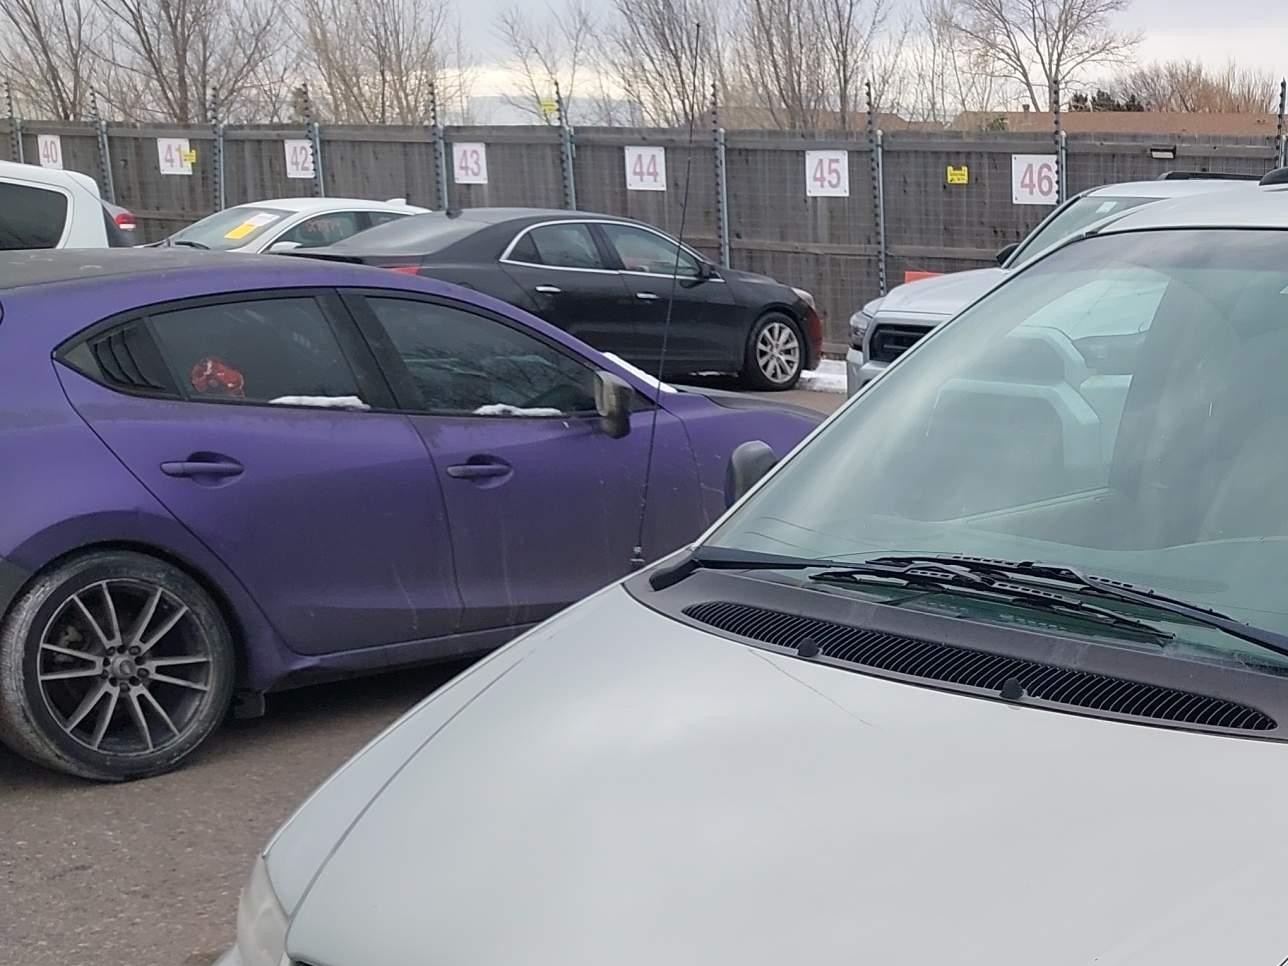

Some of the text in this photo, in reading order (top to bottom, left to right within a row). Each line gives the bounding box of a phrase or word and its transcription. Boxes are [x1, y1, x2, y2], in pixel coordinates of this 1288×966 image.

[41, 140, 59, 164] 40
[164, 143, 184, 168] 41
[290, 146, 310, 172] 42
[457, 149, 481, 177] 43
[632, 153, 660, 183] 44
[812, 158, 841, 189] 45
[1020, 163, 1053, 197] 46
